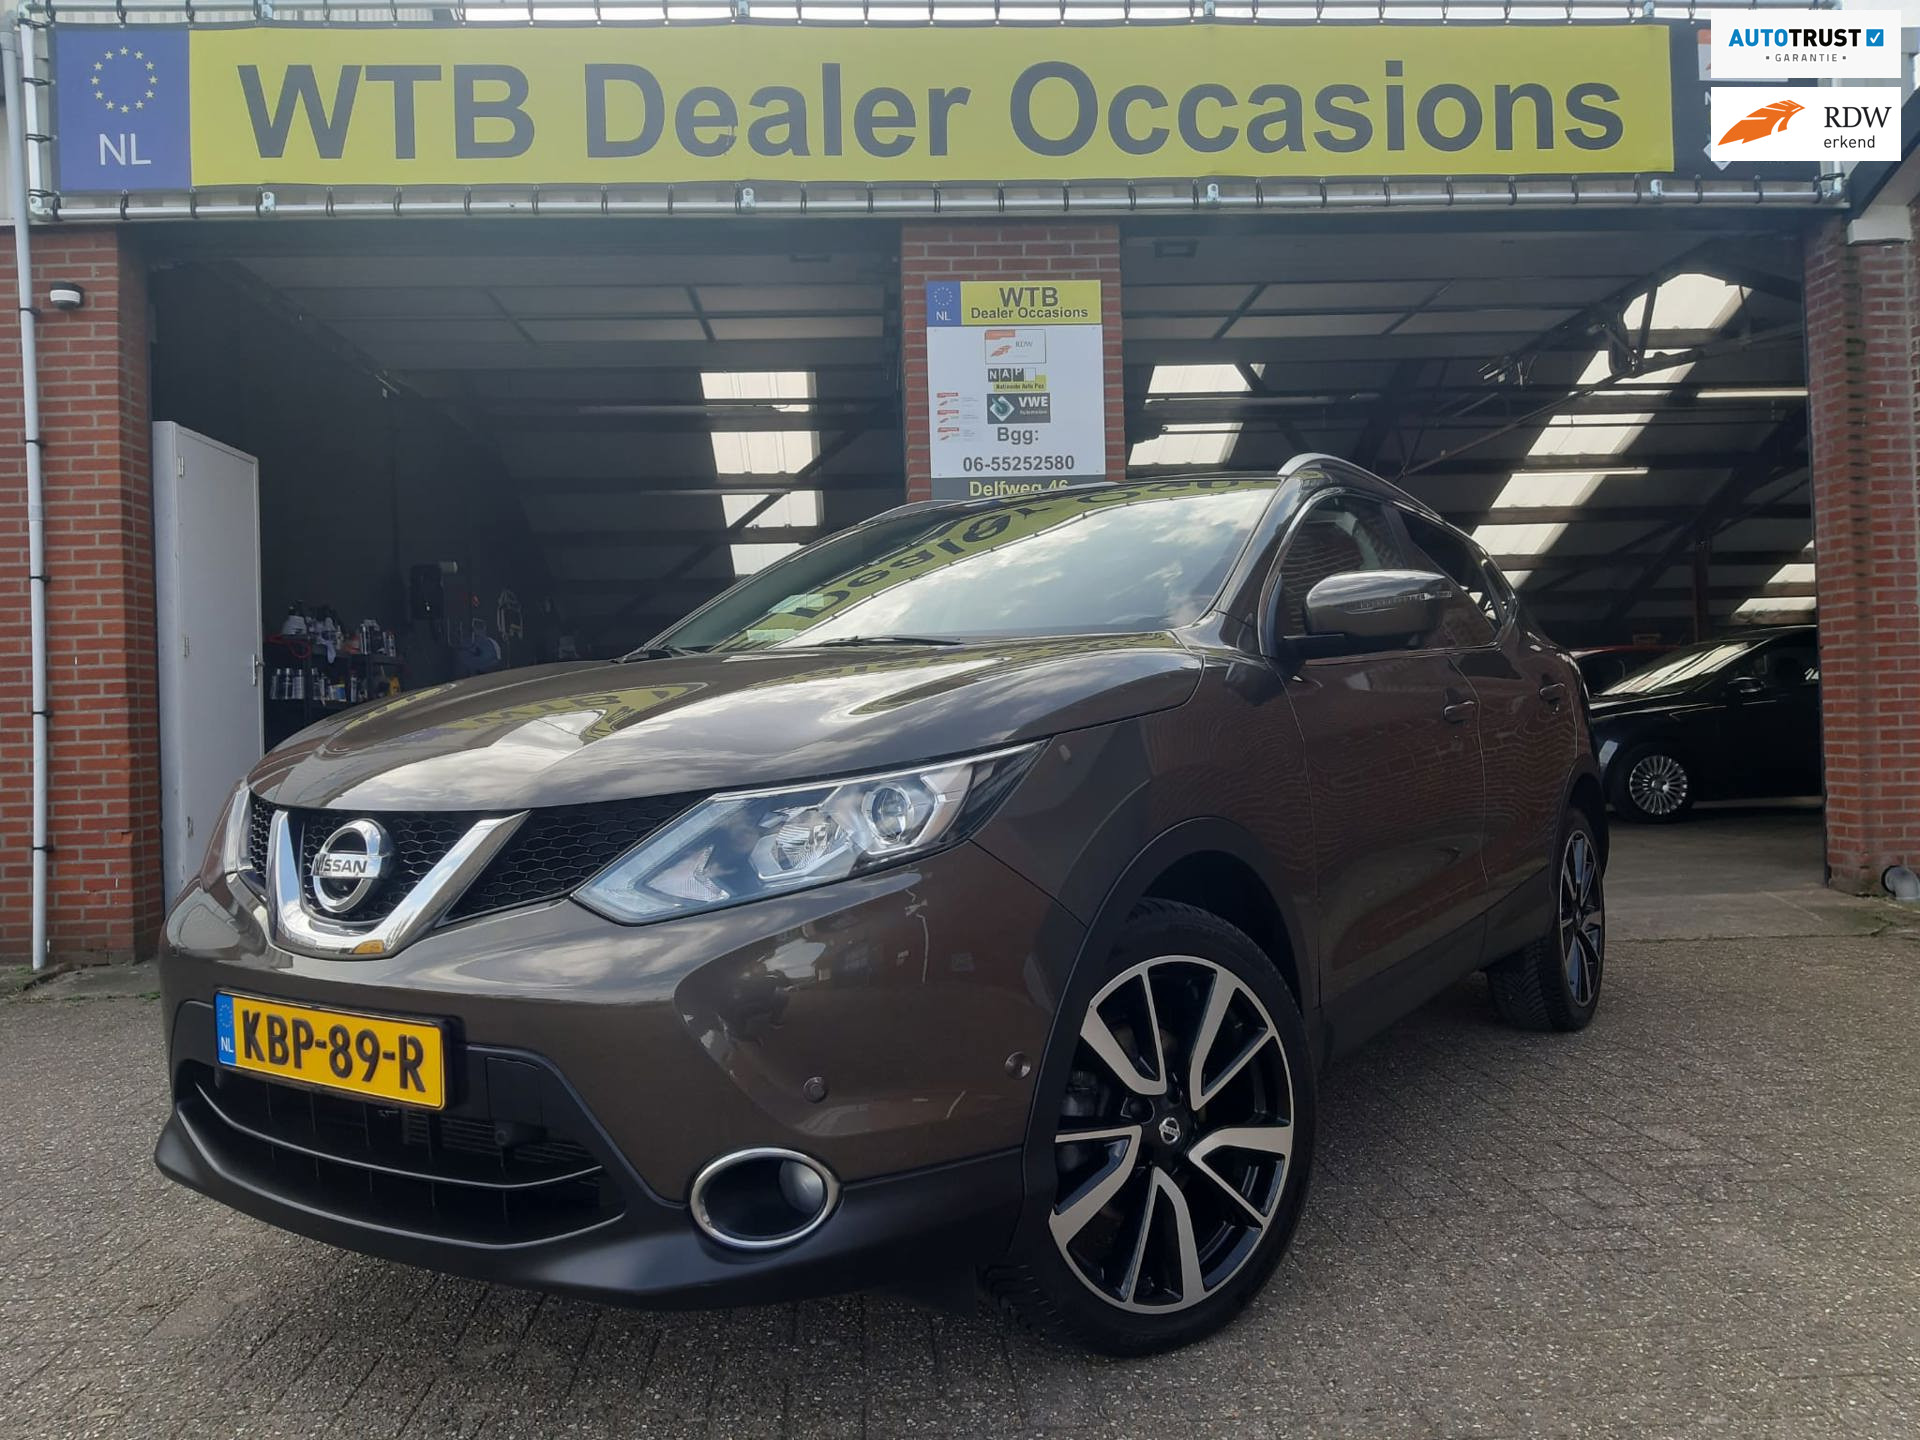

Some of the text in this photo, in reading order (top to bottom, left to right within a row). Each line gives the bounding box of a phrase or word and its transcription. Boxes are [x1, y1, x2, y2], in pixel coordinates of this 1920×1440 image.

[237, 60, 1625, 160] WTB Dealer Occasions
[98, 133, 152, 167] NL
[999, 286, 1059, 308] WTB
[935, 311, 951, 321] NL
[970, 307, 1089, 319] Dealer Occasions
[989, 367, 1023, 380] NAP
[1018, 396, 1049, 407] VWE
[996, 427, 1040, 445] Bgg:
[963, 455, 1075, 472] 06-55252580
[313, 857, 368, 874] NISSAN
[220, 1037, 235, 1053] NL
[242, 1009, 426, 1093] KBP-89-R
